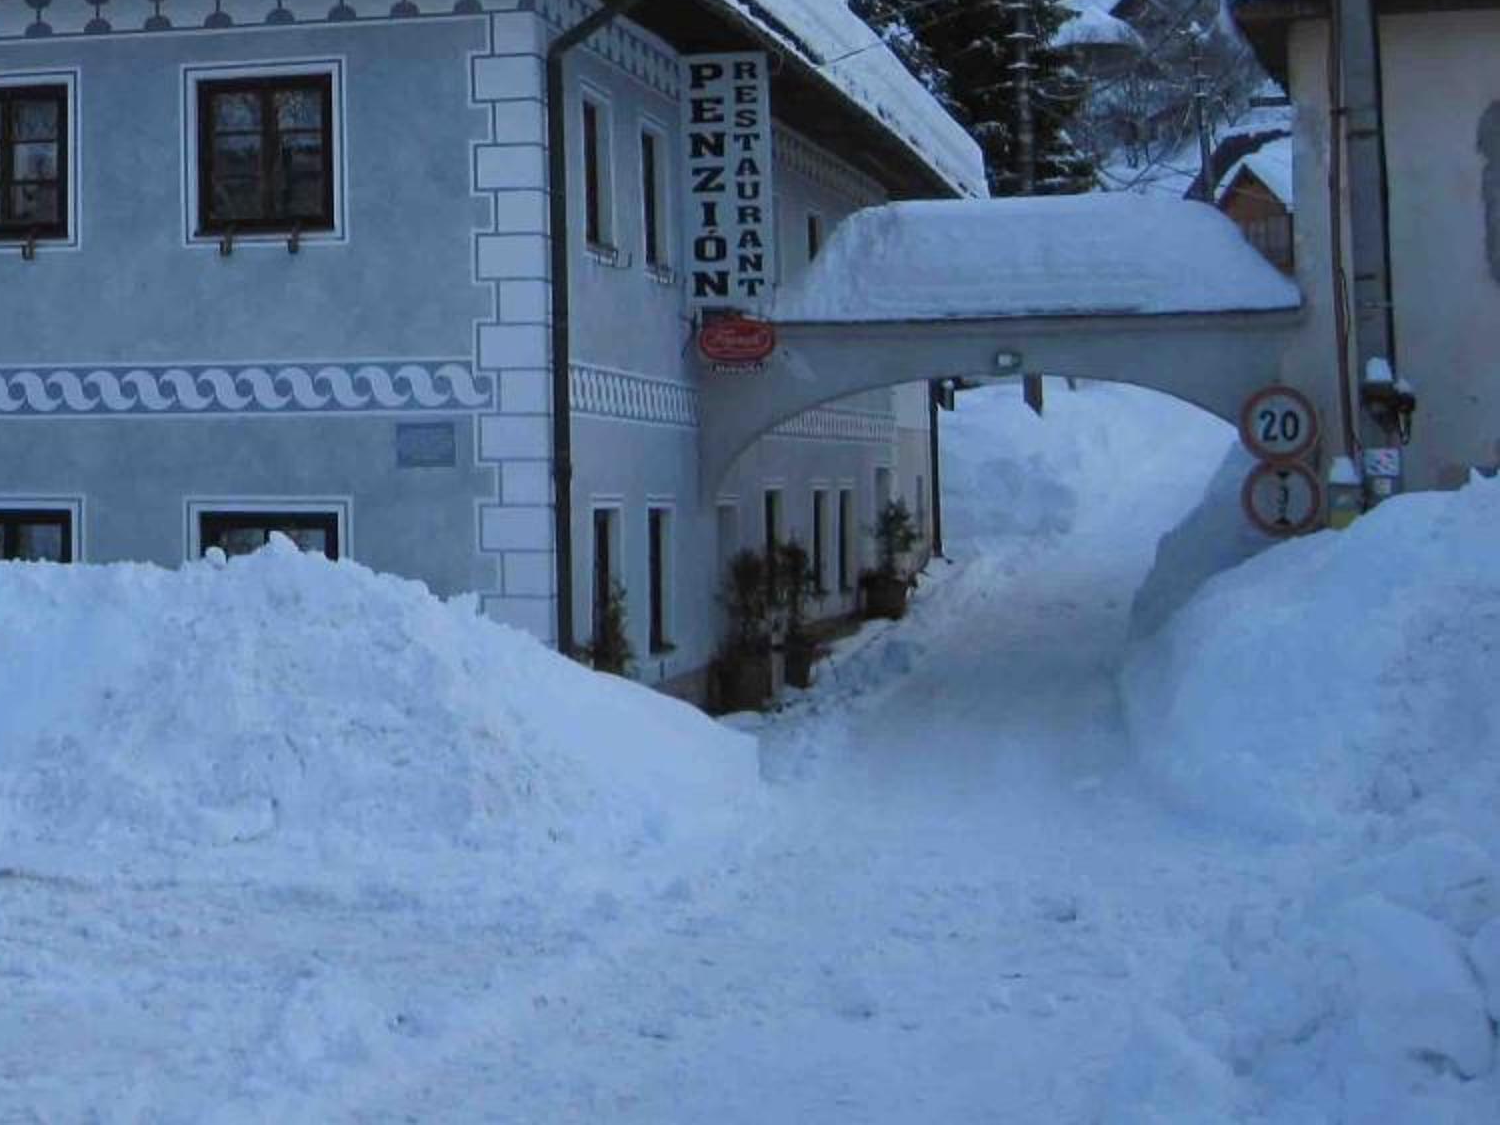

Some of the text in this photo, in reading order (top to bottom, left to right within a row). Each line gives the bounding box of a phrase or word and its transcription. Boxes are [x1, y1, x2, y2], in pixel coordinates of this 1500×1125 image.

[688, 62, 730, 298] PENZIÓN
[732, 60, 765, 297] RESTAURANT
[1259, 409, 1300, 442] 20
